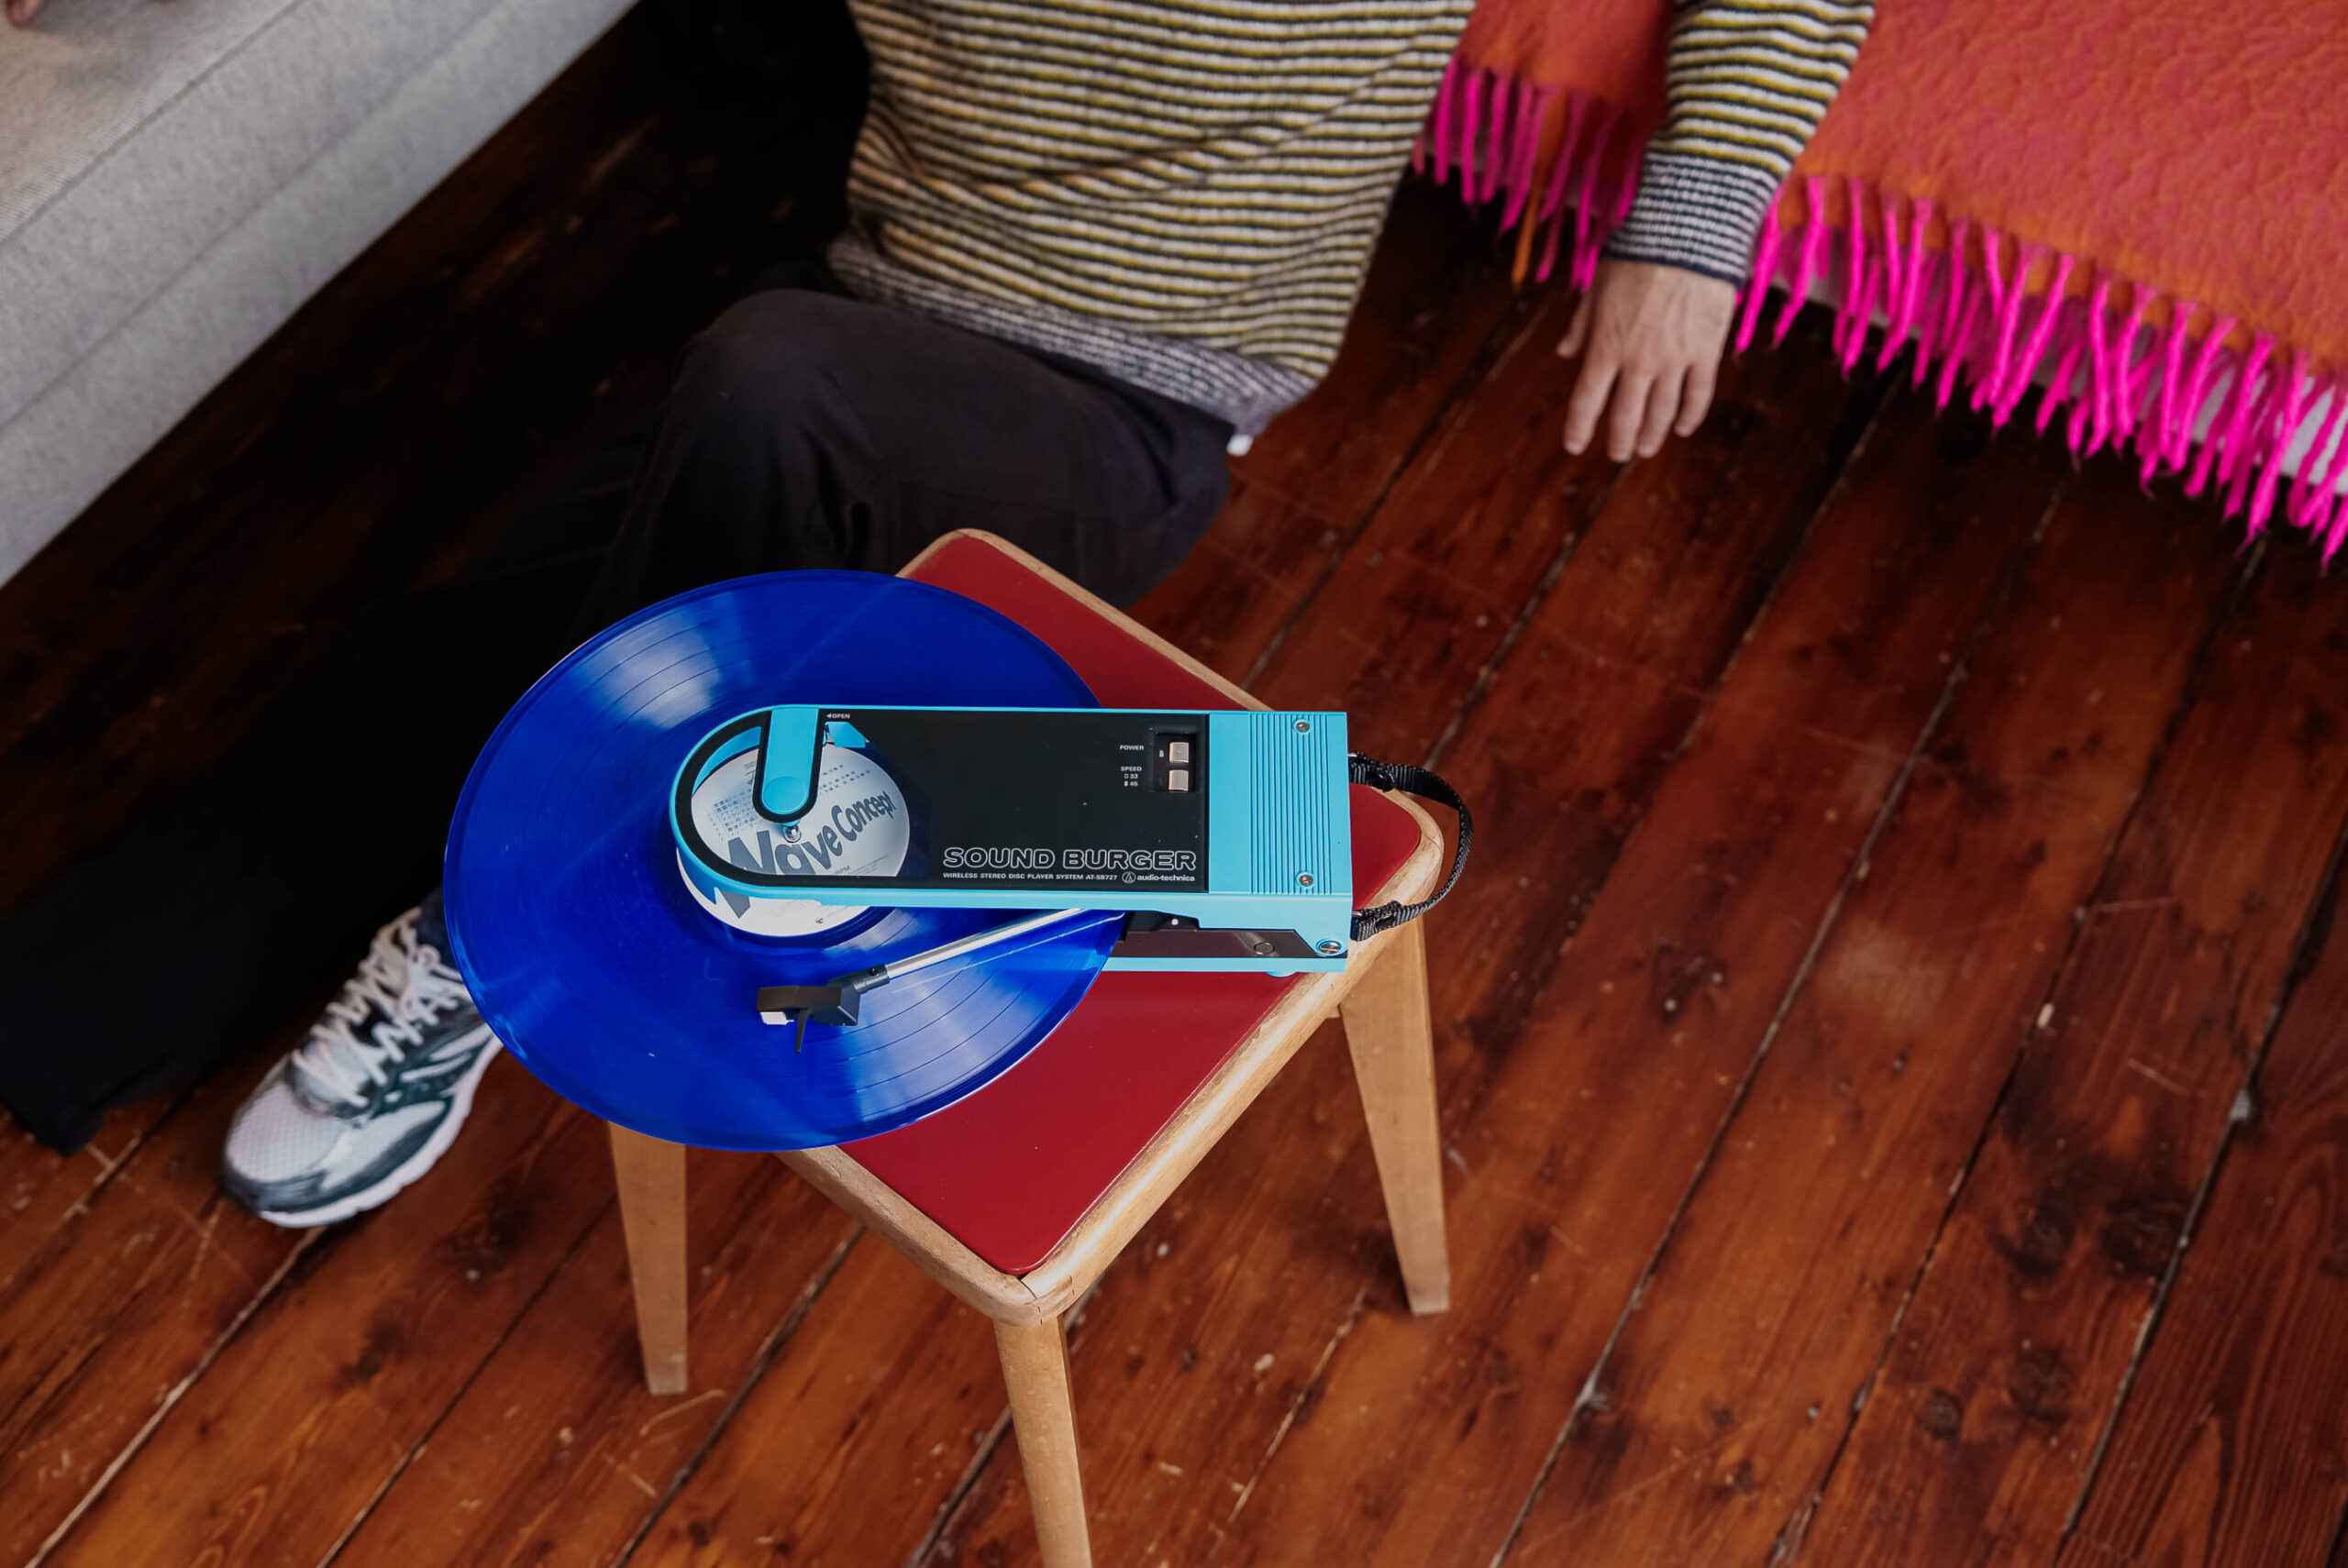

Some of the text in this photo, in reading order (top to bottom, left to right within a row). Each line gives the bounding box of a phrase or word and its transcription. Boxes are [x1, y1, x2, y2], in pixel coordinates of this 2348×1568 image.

[719, 825, 843, 919] Wave
[831, 790, 896, 842] Concept
[943, 846, 1197, 871] SOUND BURGER
[1136, 874, 1196, 882] audio-technica
